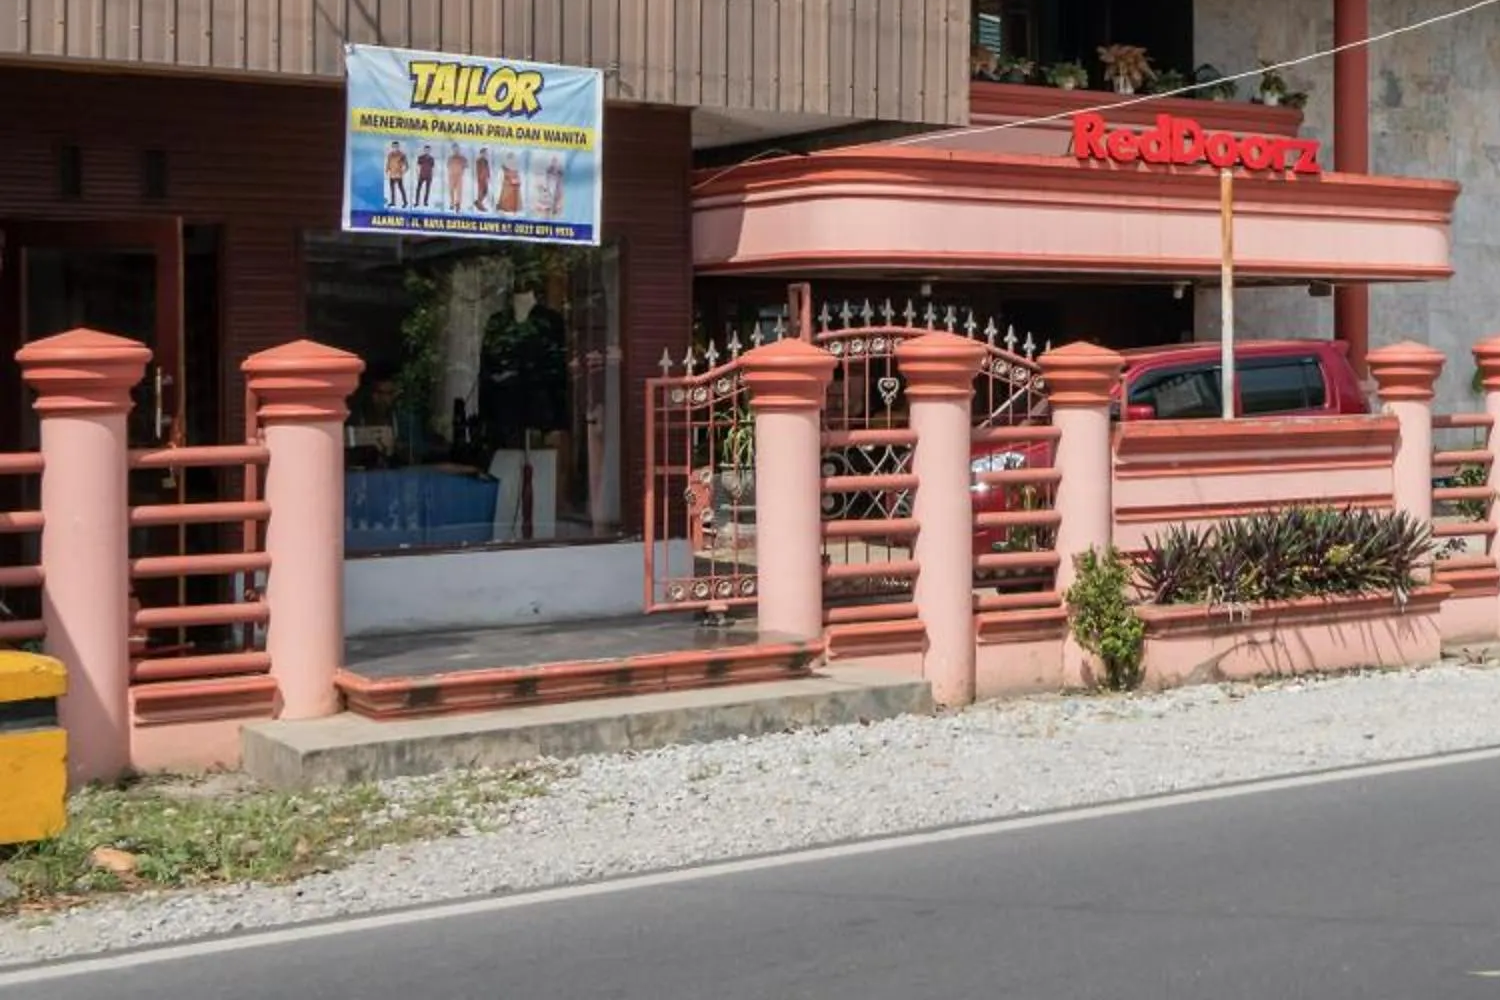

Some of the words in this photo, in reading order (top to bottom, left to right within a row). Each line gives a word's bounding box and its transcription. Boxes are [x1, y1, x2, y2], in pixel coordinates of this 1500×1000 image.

[410, 61, 544, 118] TAILOR
[360, 113, 429, 132] MENERIMA
[431, 119, 484, 137] PAKAIAN
[488, 123, 513, 139] PRIA
[516, 126, 540, 141] DAN
[543, 130, 587, 145] WANITA
[1074, 113, 1321, 173] RedDoorz
